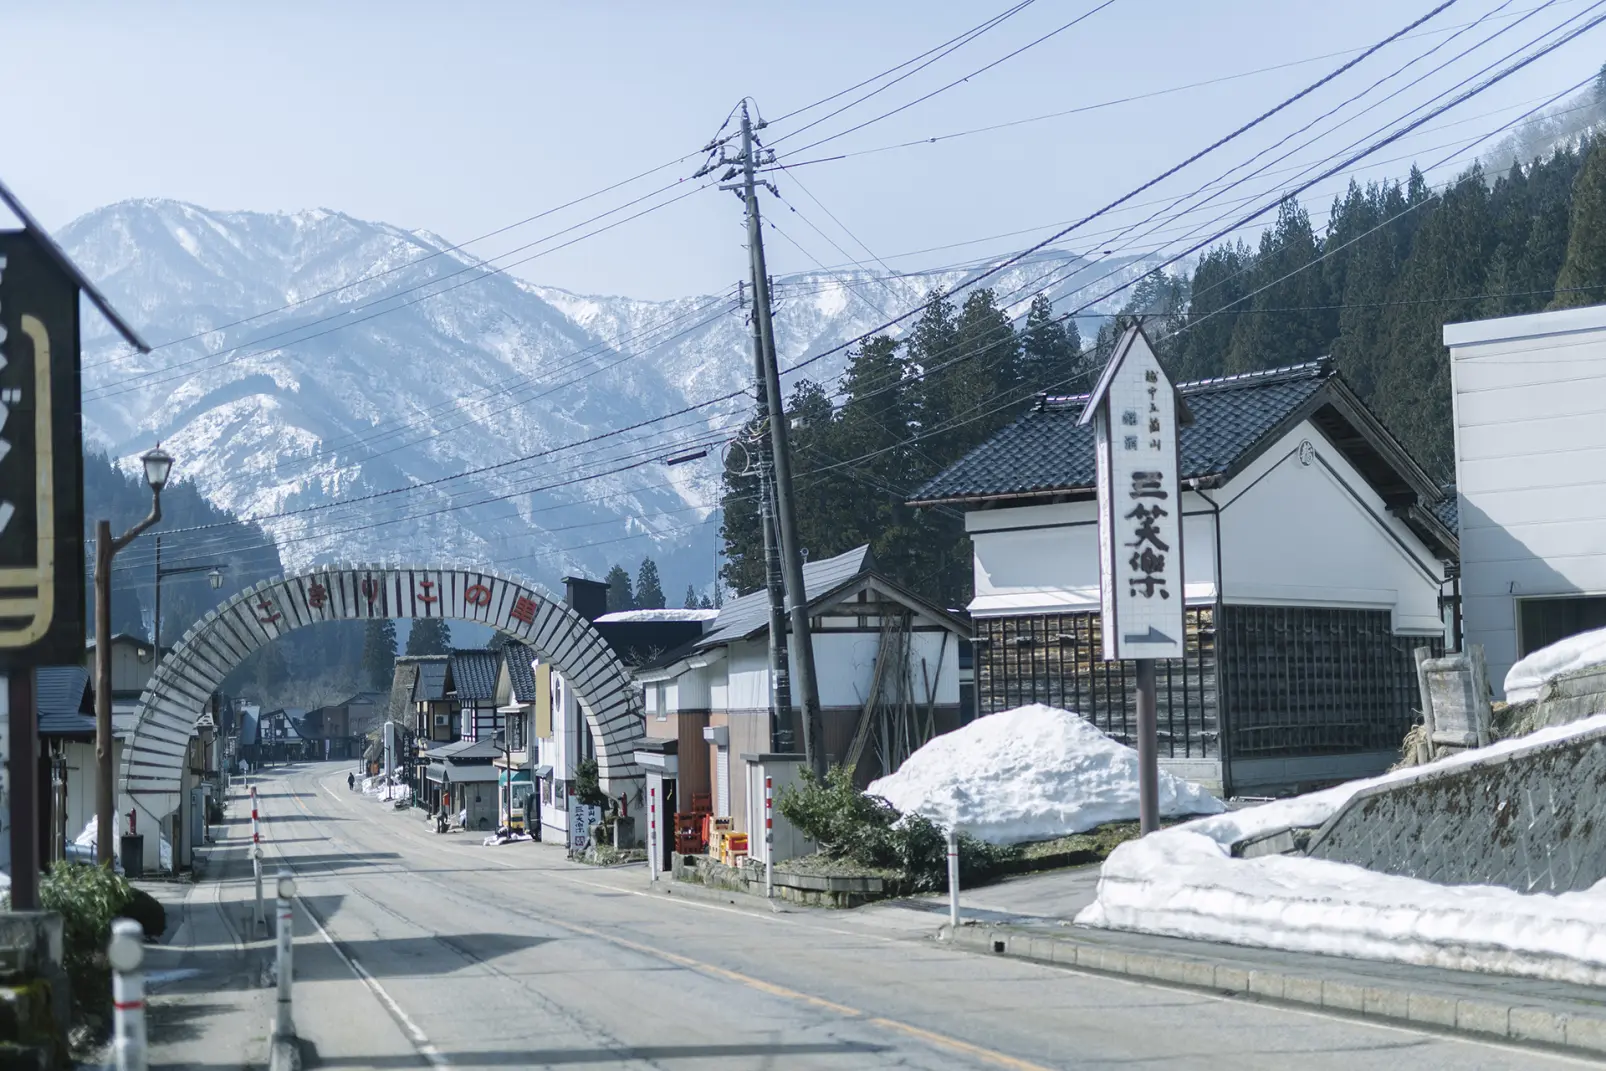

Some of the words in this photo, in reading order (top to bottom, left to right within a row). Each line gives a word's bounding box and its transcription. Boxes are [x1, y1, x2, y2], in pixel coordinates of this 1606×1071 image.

[257, 579, 538, 624] こきりこの里
